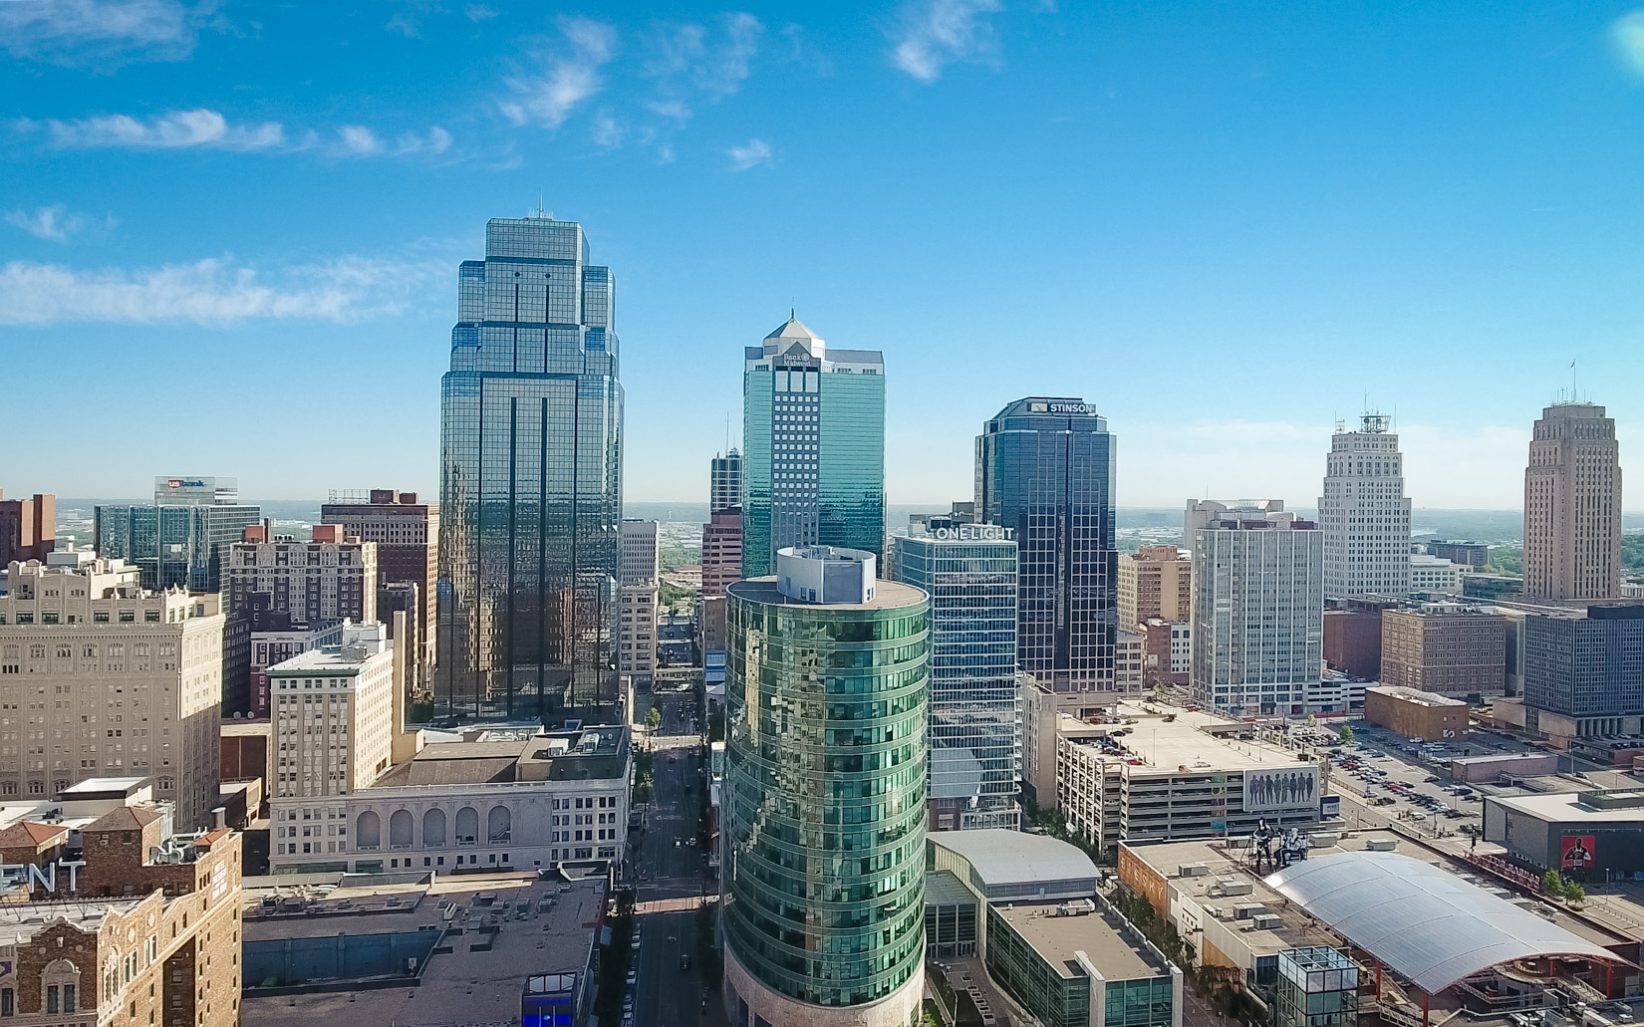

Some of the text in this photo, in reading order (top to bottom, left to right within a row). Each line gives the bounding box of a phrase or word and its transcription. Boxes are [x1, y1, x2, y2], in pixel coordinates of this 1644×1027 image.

[1050, 403, 1092, 412] STINSON
[936, 527, 1015, 540] ONE LIGHT
